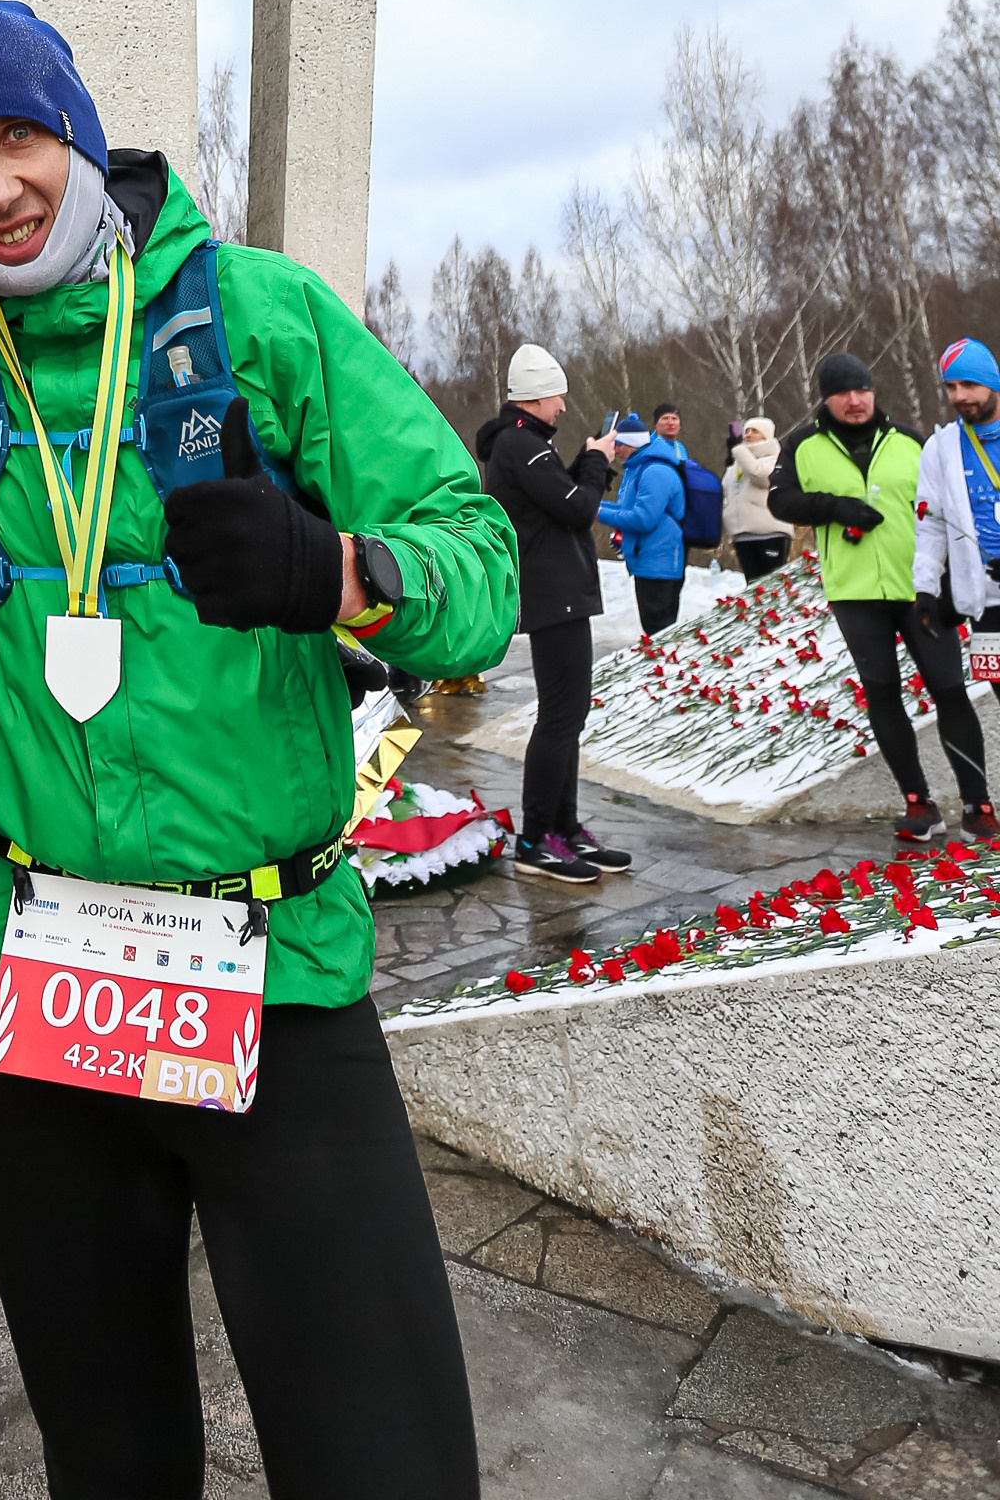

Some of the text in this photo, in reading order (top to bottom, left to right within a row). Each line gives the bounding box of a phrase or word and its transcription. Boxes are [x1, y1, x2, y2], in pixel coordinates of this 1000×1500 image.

[178, 433, 221, 457] AONIJ
[186, 448, 221, 463] Runnin
[972, 655, 1000, 671] 028
[77, 902, 134, 923] ДОРОГА
[141, 911, 202, 932] ЖИЗНИ
[24, 932, 37, 940] tech
[45, 934, 72, 943] MARVEL
[41, 970, 209, 1049] 0048
[157, 1058, 225, 1100] B10
